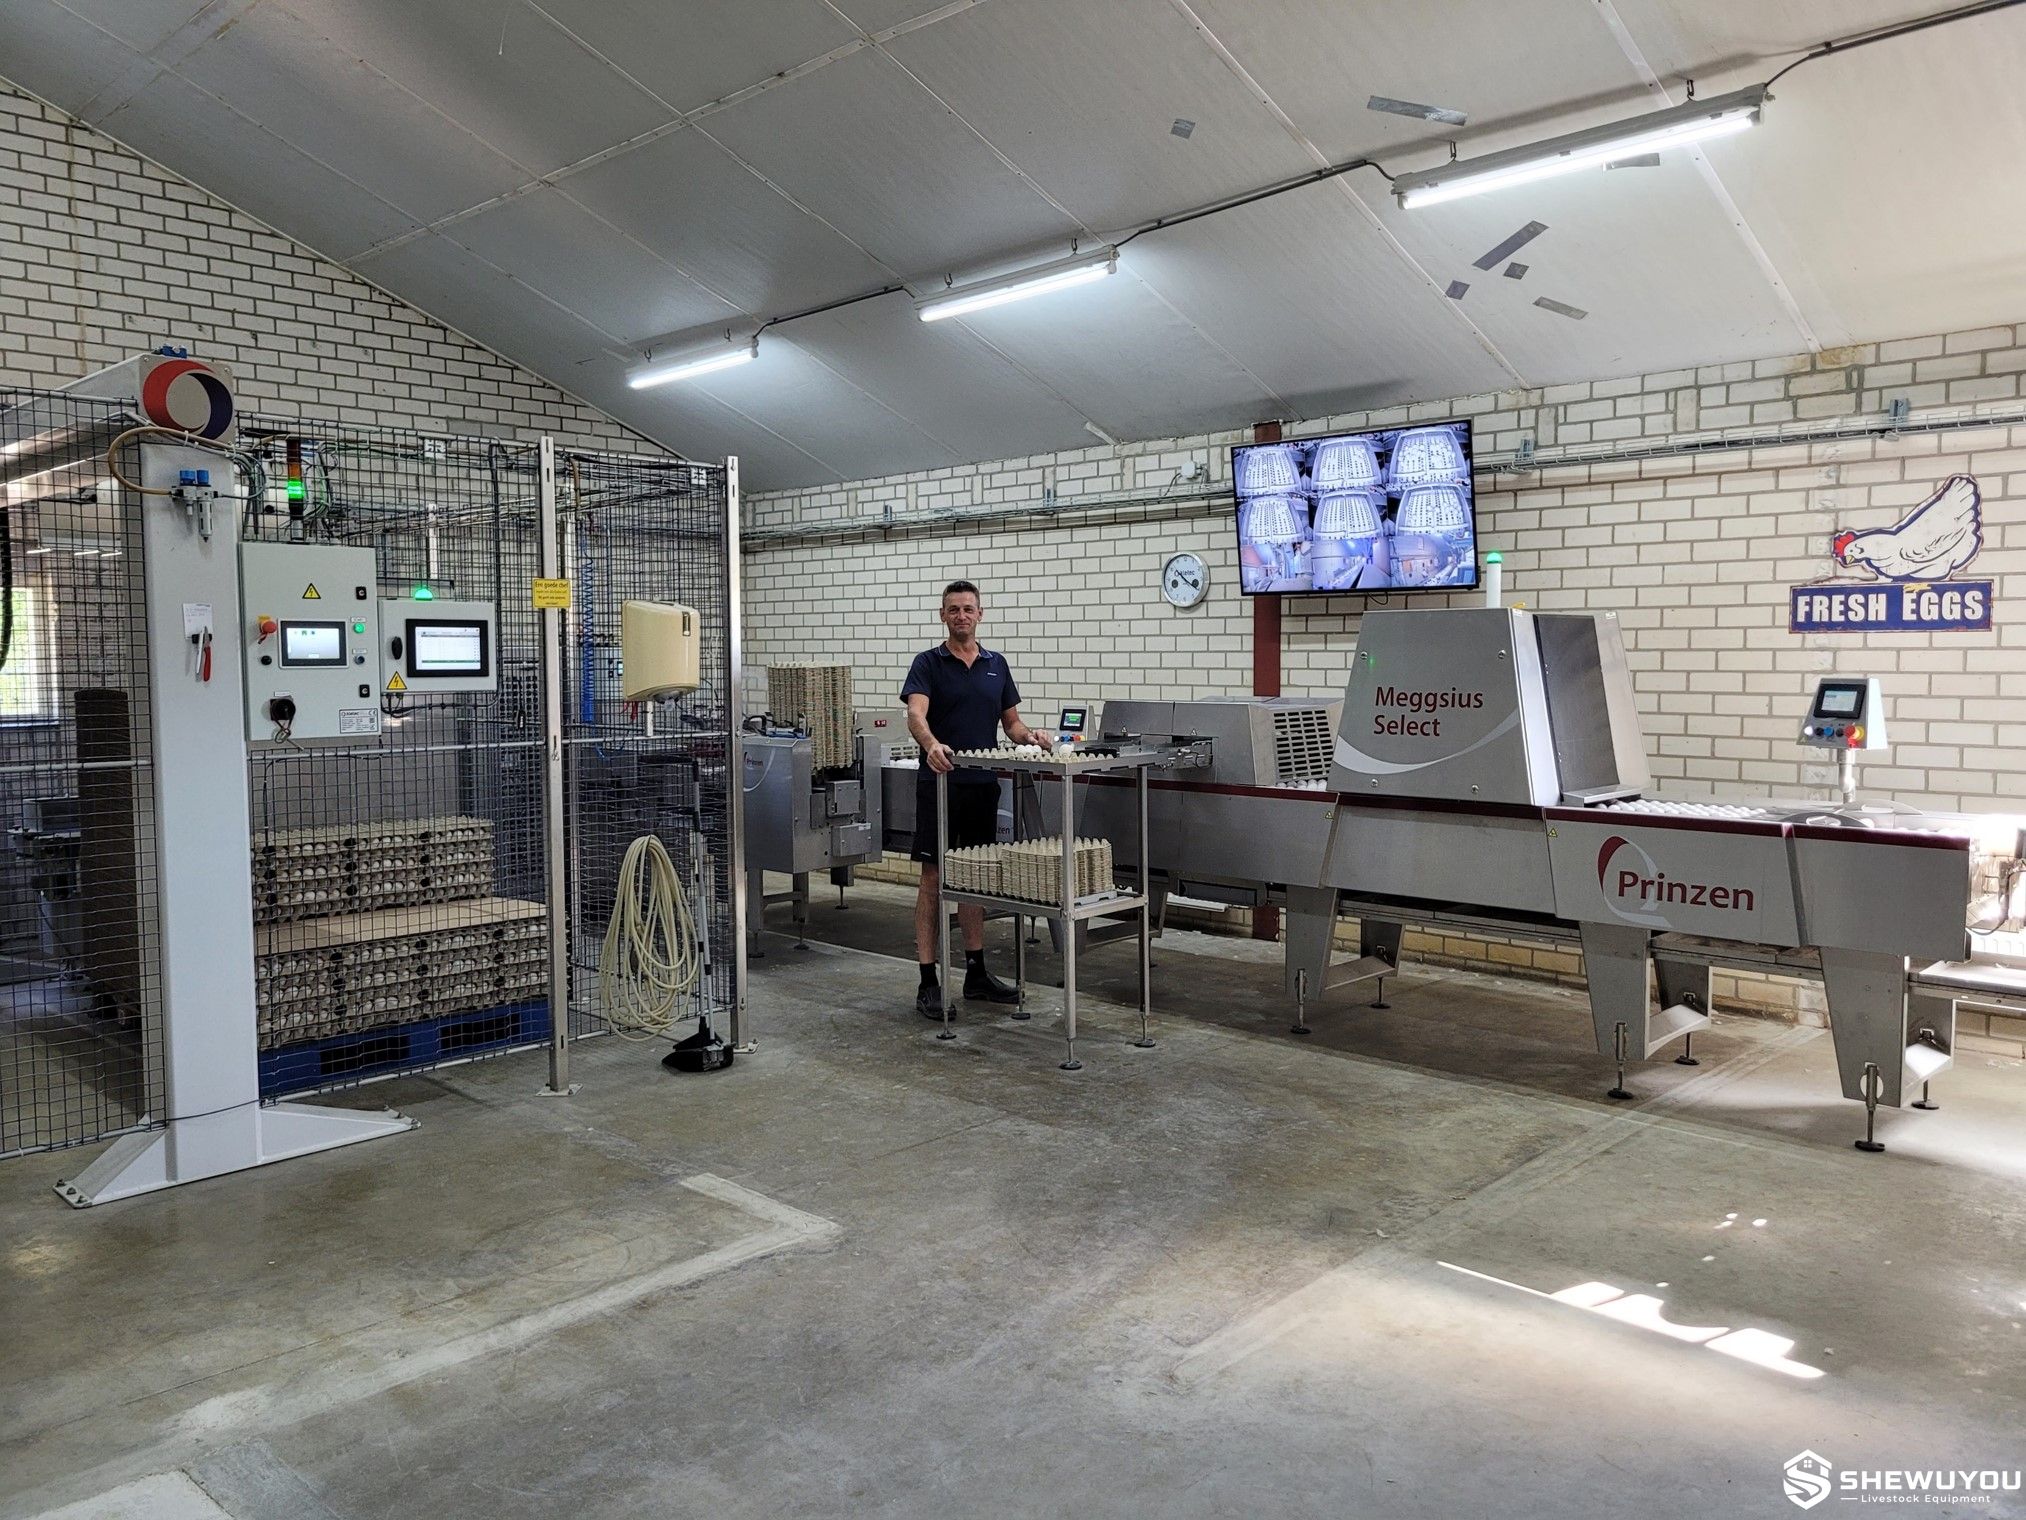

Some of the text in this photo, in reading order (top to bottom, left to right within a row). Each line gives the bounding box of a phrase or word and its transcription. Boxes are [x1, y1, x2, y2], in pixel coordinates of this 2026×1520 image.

[1797, 590, 1983, 622] FRESH EGGS
[1375, 686, 1484, 713] Meggsius
[1373, 714, 1440, 737] Select
[1618, 870, 1754, 911] Prinzen
